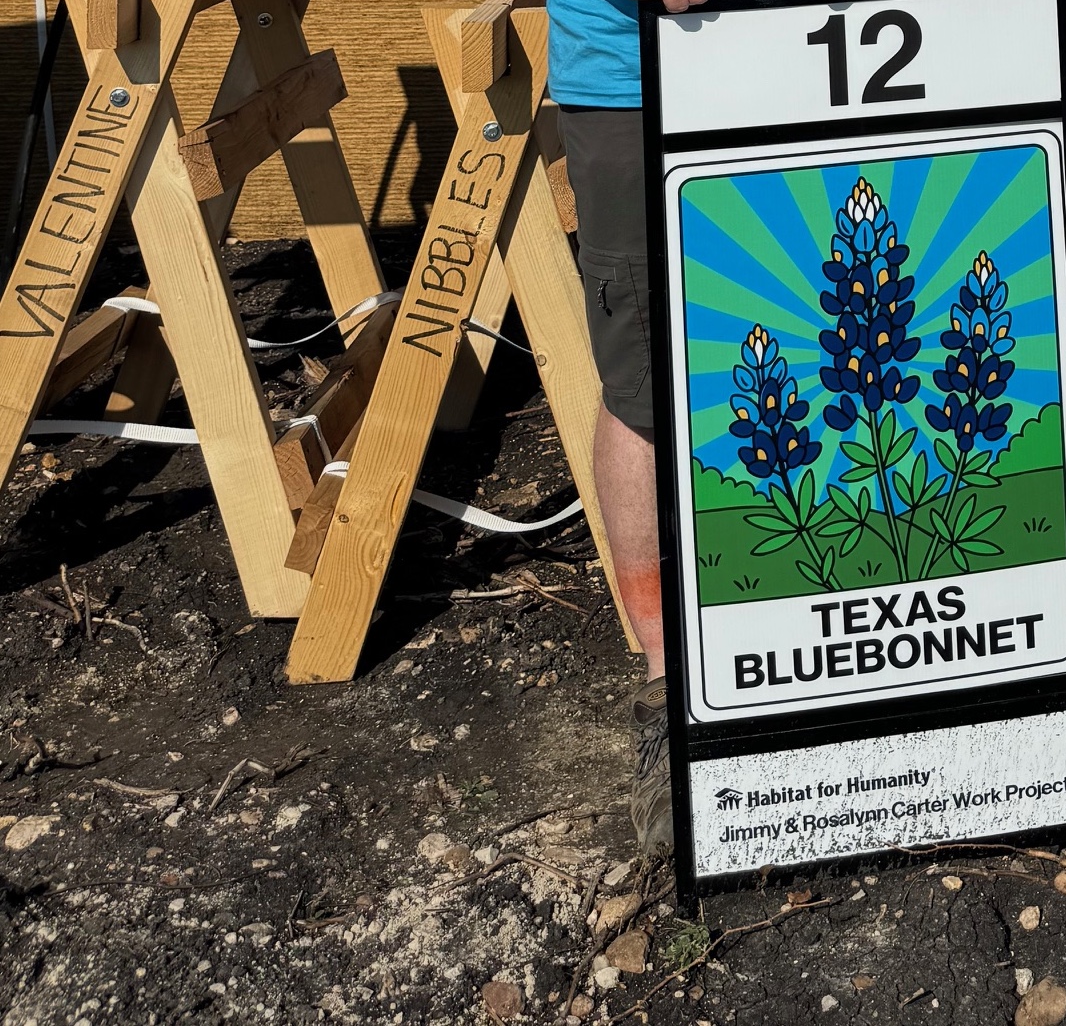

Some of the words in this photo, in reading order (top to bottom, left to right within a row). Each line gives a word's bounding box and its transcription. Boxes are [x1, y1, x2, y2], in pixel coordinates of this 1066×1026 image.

[807, 9, 926, 106] 12
[0, 84, 139, 337] VALENTINE
[402, 149, 505, 358] NIBBLES
[811, 585, 966, 638] TEXAS
[734, 613, 1044, 690] BLUEBONNET
[719, 821, 781, 844] Jimmy
[785, 818, 799, 834] &
[802, 806, 889, 833] Rosalynn
[891, 797, 950, 819] Carter
[952, 790, 1002, 808] Work
[747, 786, 813, 808] Habitat
[816, 782, 843, 799] for
[847, 769, 931, 794] Humanity
